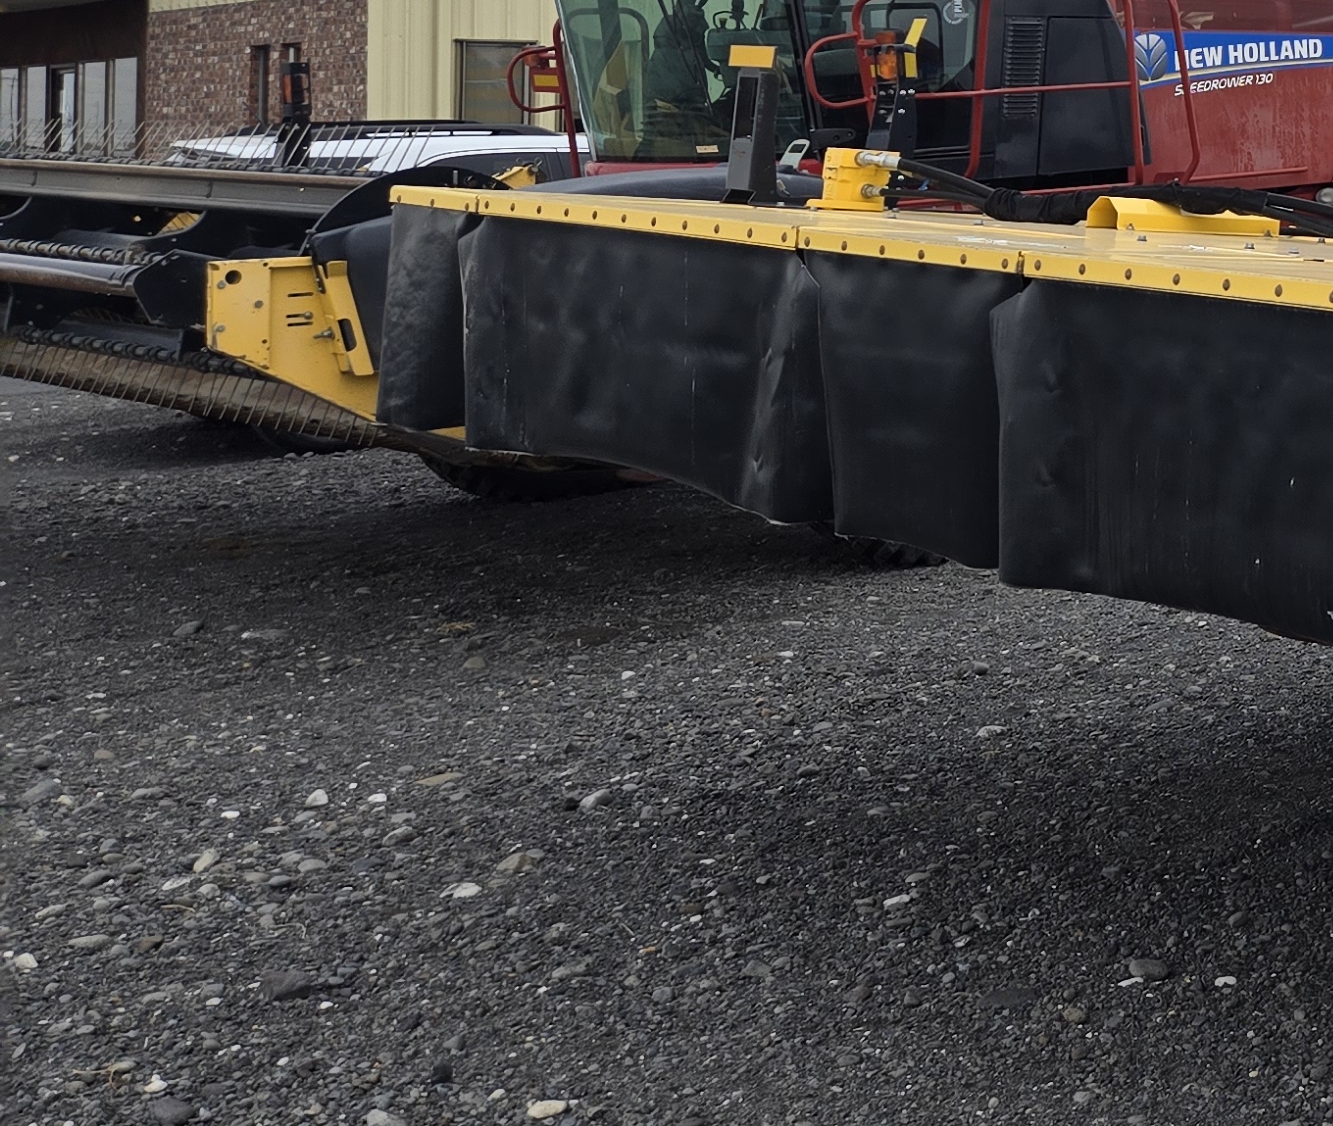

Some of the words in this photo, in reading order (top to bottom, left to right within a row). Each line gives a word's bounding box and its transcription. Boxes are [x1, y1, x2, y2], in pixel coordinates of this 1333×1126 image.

[1228, 39, 1323, 65] HOLLAND
[1174, 74, 1253, 96] SEEDROWER
[1255, 73, 1274, 85] 130
